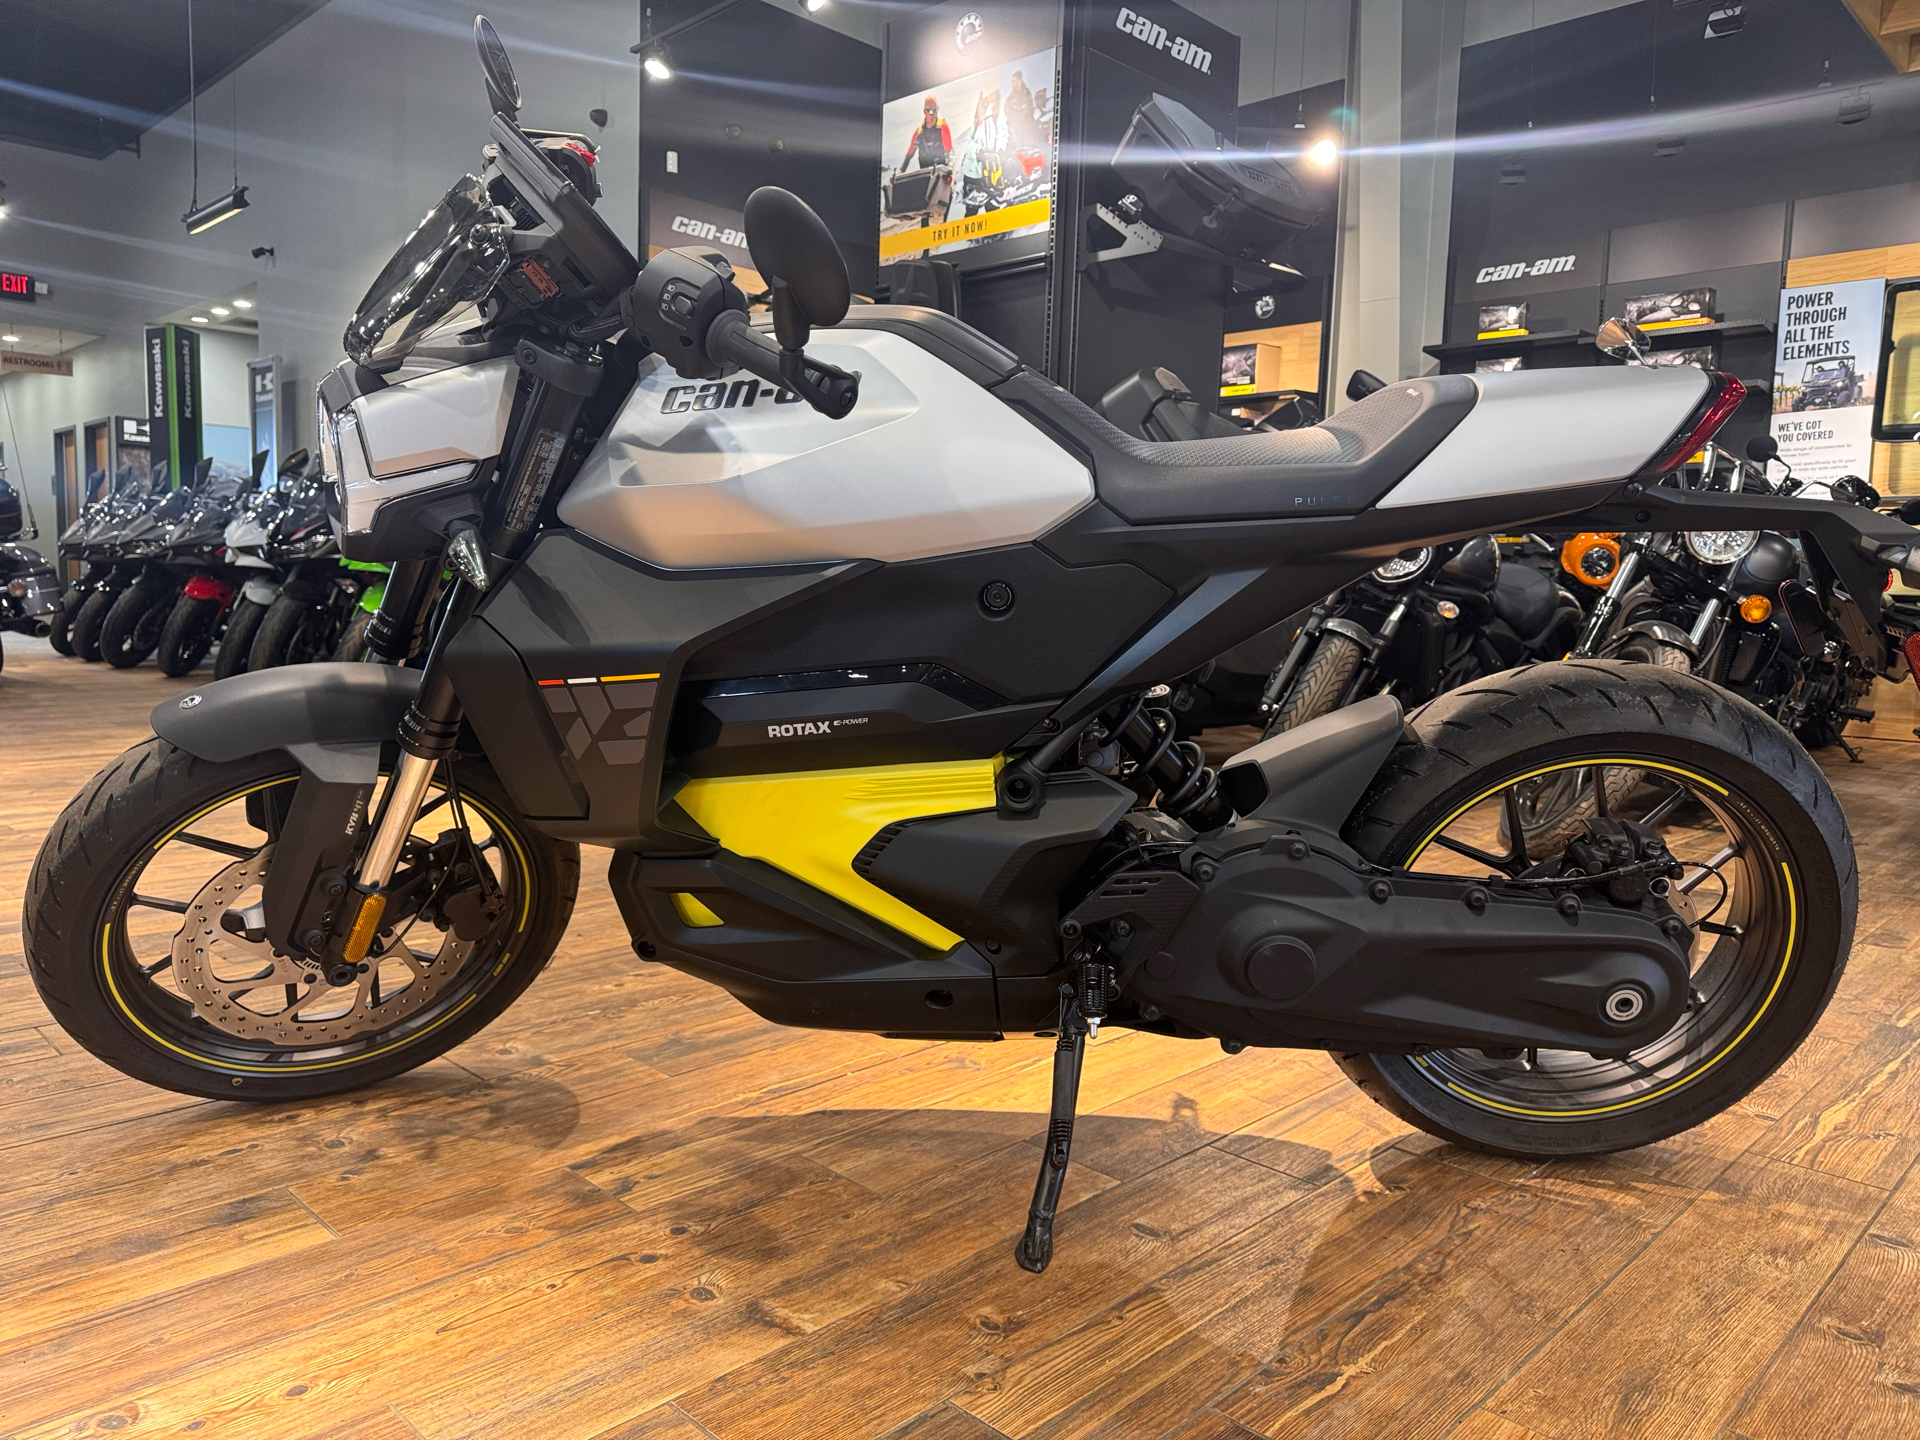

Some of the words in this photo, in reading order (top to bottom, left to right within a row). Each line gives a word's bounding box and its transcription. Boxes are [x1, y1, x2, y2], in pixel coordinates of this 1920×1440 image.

[1116, 7, 1211, 75] can-am
[932, 227, 948, 242] TRY
[952, 226, 961, 237] IT
[964, 219, 988, 234] NOW!
[1475, 254, 1577, 284] can-am
[2, 273, 28, 294] EXIT
[1787, 291, 1834, 310] POWER
[1786, 306, 1847, 327] THROUGH
[1784, 328, 1806, 344] ALL
[1810, 325, 1835, 340] THE
[1783, 340, 1850, 360] ELEMENTS
[3, 356, 55, 368] RESTROOMS
[151, 338, 163, 417] Kawasaki
[182, 339, 192, 419] Kawasaki
[660, 378, 804, 414] can-a
[1778, 421, 1803, 432] WE'VE
[1806, 420, 1822, 430] GOT
[1778, 434, 1793, 443] YOU
[1796, 430, 1834, 441] COVERED
[767, 720, 831, 738] ROTAX
